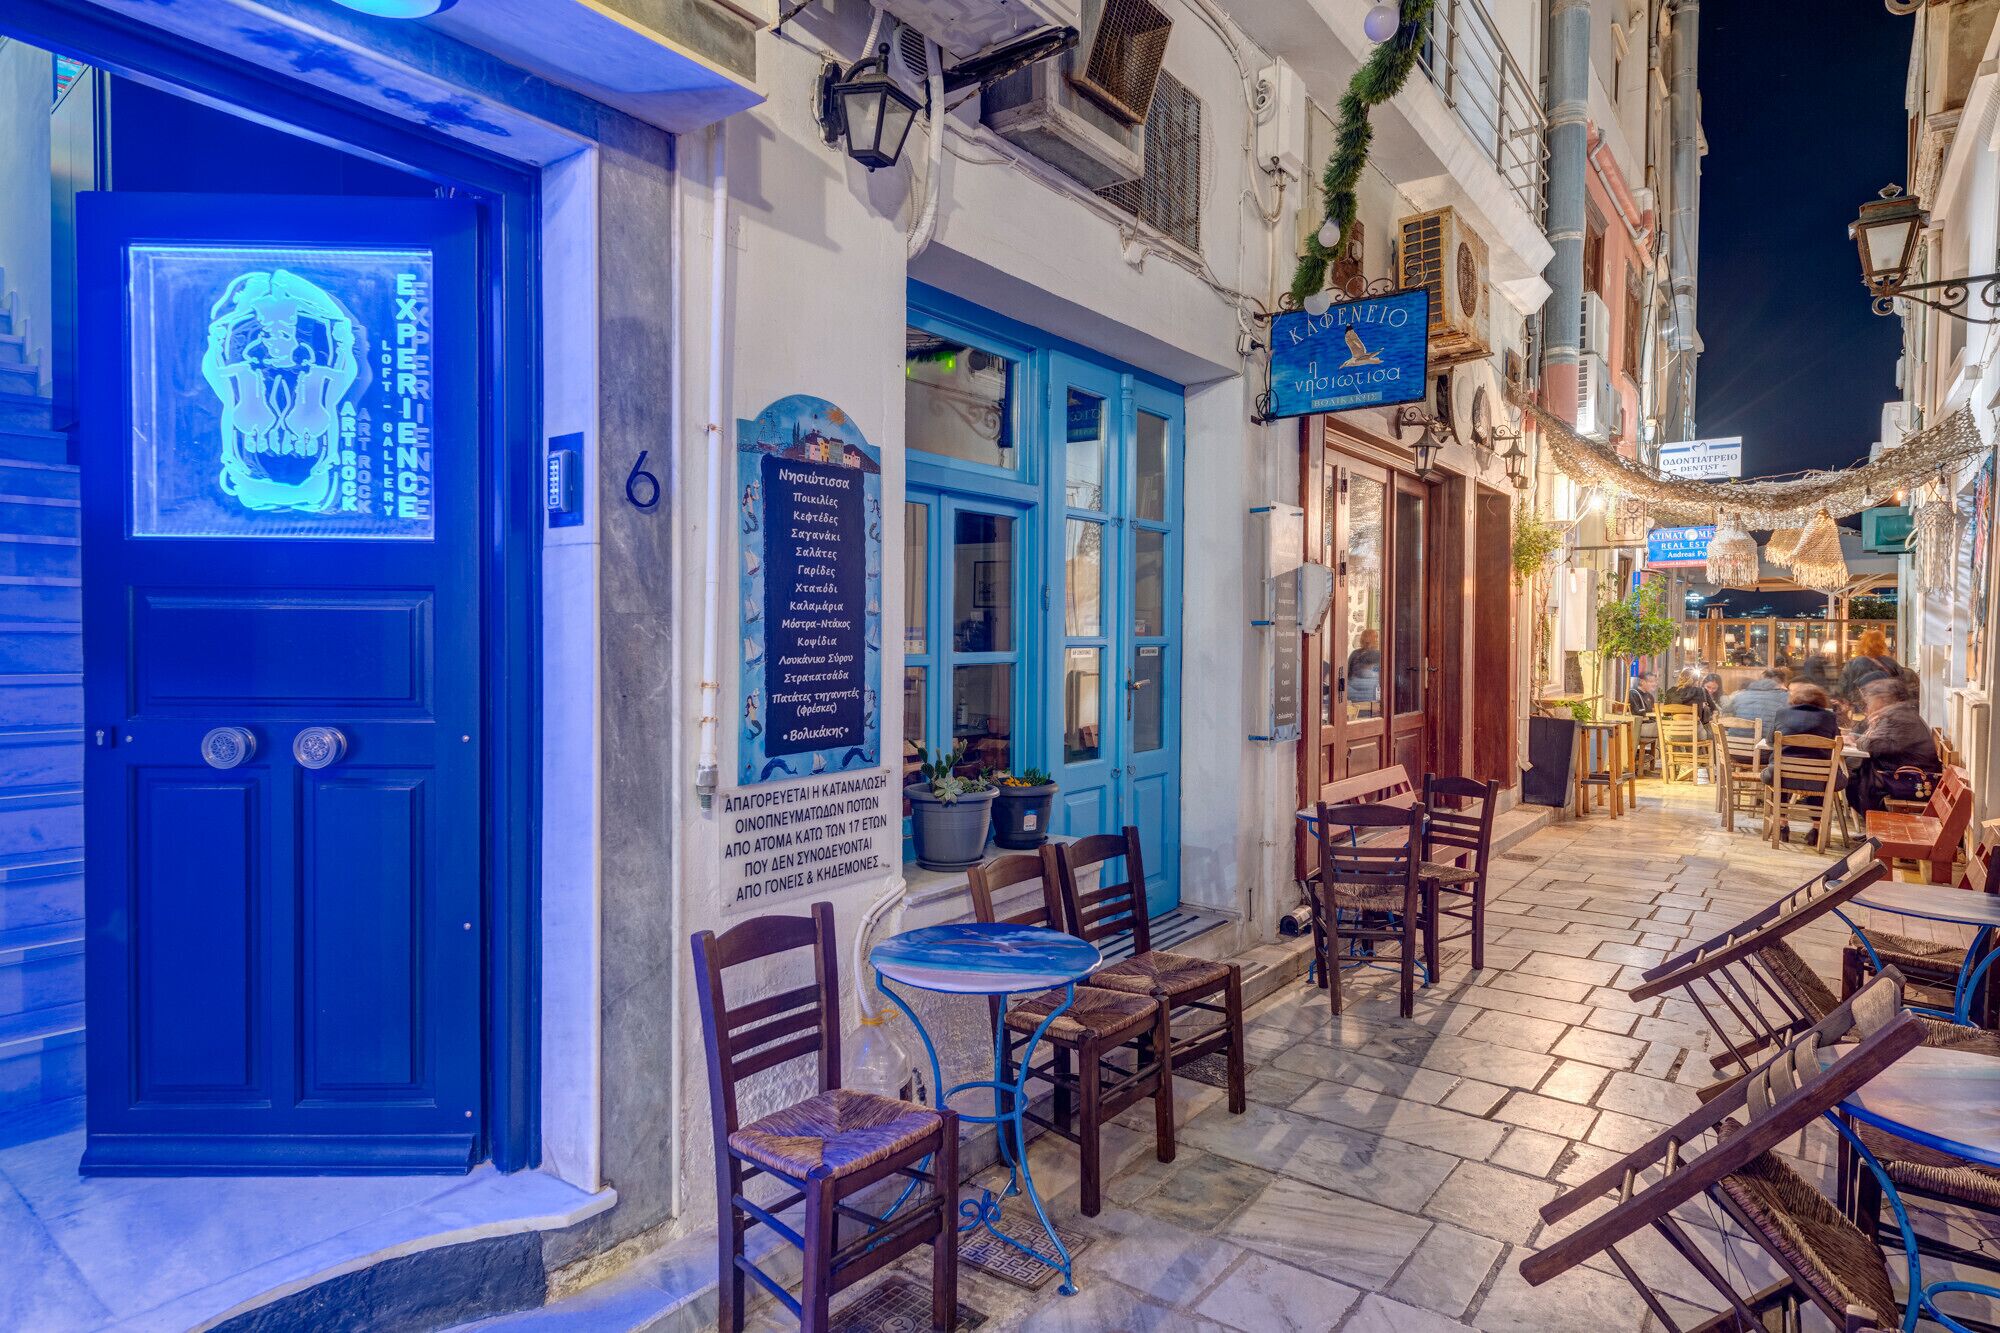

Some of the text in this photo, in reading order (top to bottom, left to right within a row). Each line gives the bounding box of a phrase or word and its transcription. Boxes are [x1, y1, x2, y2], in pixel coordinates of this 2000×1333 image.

[1288, 304, 1408, 346] ΚΑΦΕΝΕΙΟ
[381, 340, 393, 392] LOFT
[1308, 361, 1317, 379] η
[395, 273, 418, 518] EXPERIENCE
[340, 401, 358, 512] ART ROCK
[1662, 453, 1738, 467] ΟΔΟΝΤΙΑΤΡΕΙΟ
[382, 422, 394, 516] GALLERY
[1680, 464, 1719, 473] DENTIST
[626, 450, 660, 507] 6
[779, 468, 850, 490] Νησιώτισσα
[793, 492, 839, 509] Ποικιλίες
[793, 510, 839, 527] Κεφτέδες
[790, 528, 841, 542] Σαγανάκι
[795, 547, 837, 561] Σαλάτες
[797, 564, 836, 579] Γαρίδες
[795, 581, 838, 594] Χταπόδι
[789, 600, 844, 613] Καλαμάρια
[781, 619, 851, 631] Μόστρα-Ντάκος
[797, 636, 837, 648] Κοψίδια
[778, 653, 853, 665] Λουκάνικο Σύρου
[783, 672, 849, 685] Στραπατσάδα
[772, 687, 860, 704] Πατάτες τηγανητές
[796, 702, 838, 718] (φρέσκες)
[725, 775, 887, 813] ΑΠΑΓΟΡΕΥΕΤΑΙ Η ΚΑΤΑΝΑΛΩΣΗ
[735, 796, 879, 834] ΟΙΝΟΠΝΕΥΜΑΤΩΔΩΝ ΠΟΤΩΝ
[725, 814, 887, 859] ΑΠΟ ΑΤΟΜΑ ΚΑΤΩ ΤΩΝ 17 ΕΤΩΝ
[744, 837, 873, 877] ΠΟΥ ΔΕΝ ΣΥΝΟΔΕΥΟΝΤΑΙ
[736, 855, 879, 902] ΑΠΟ ΓΟΝΕΙΣ & ΚΗΔΕΜΟΝΕΣ
